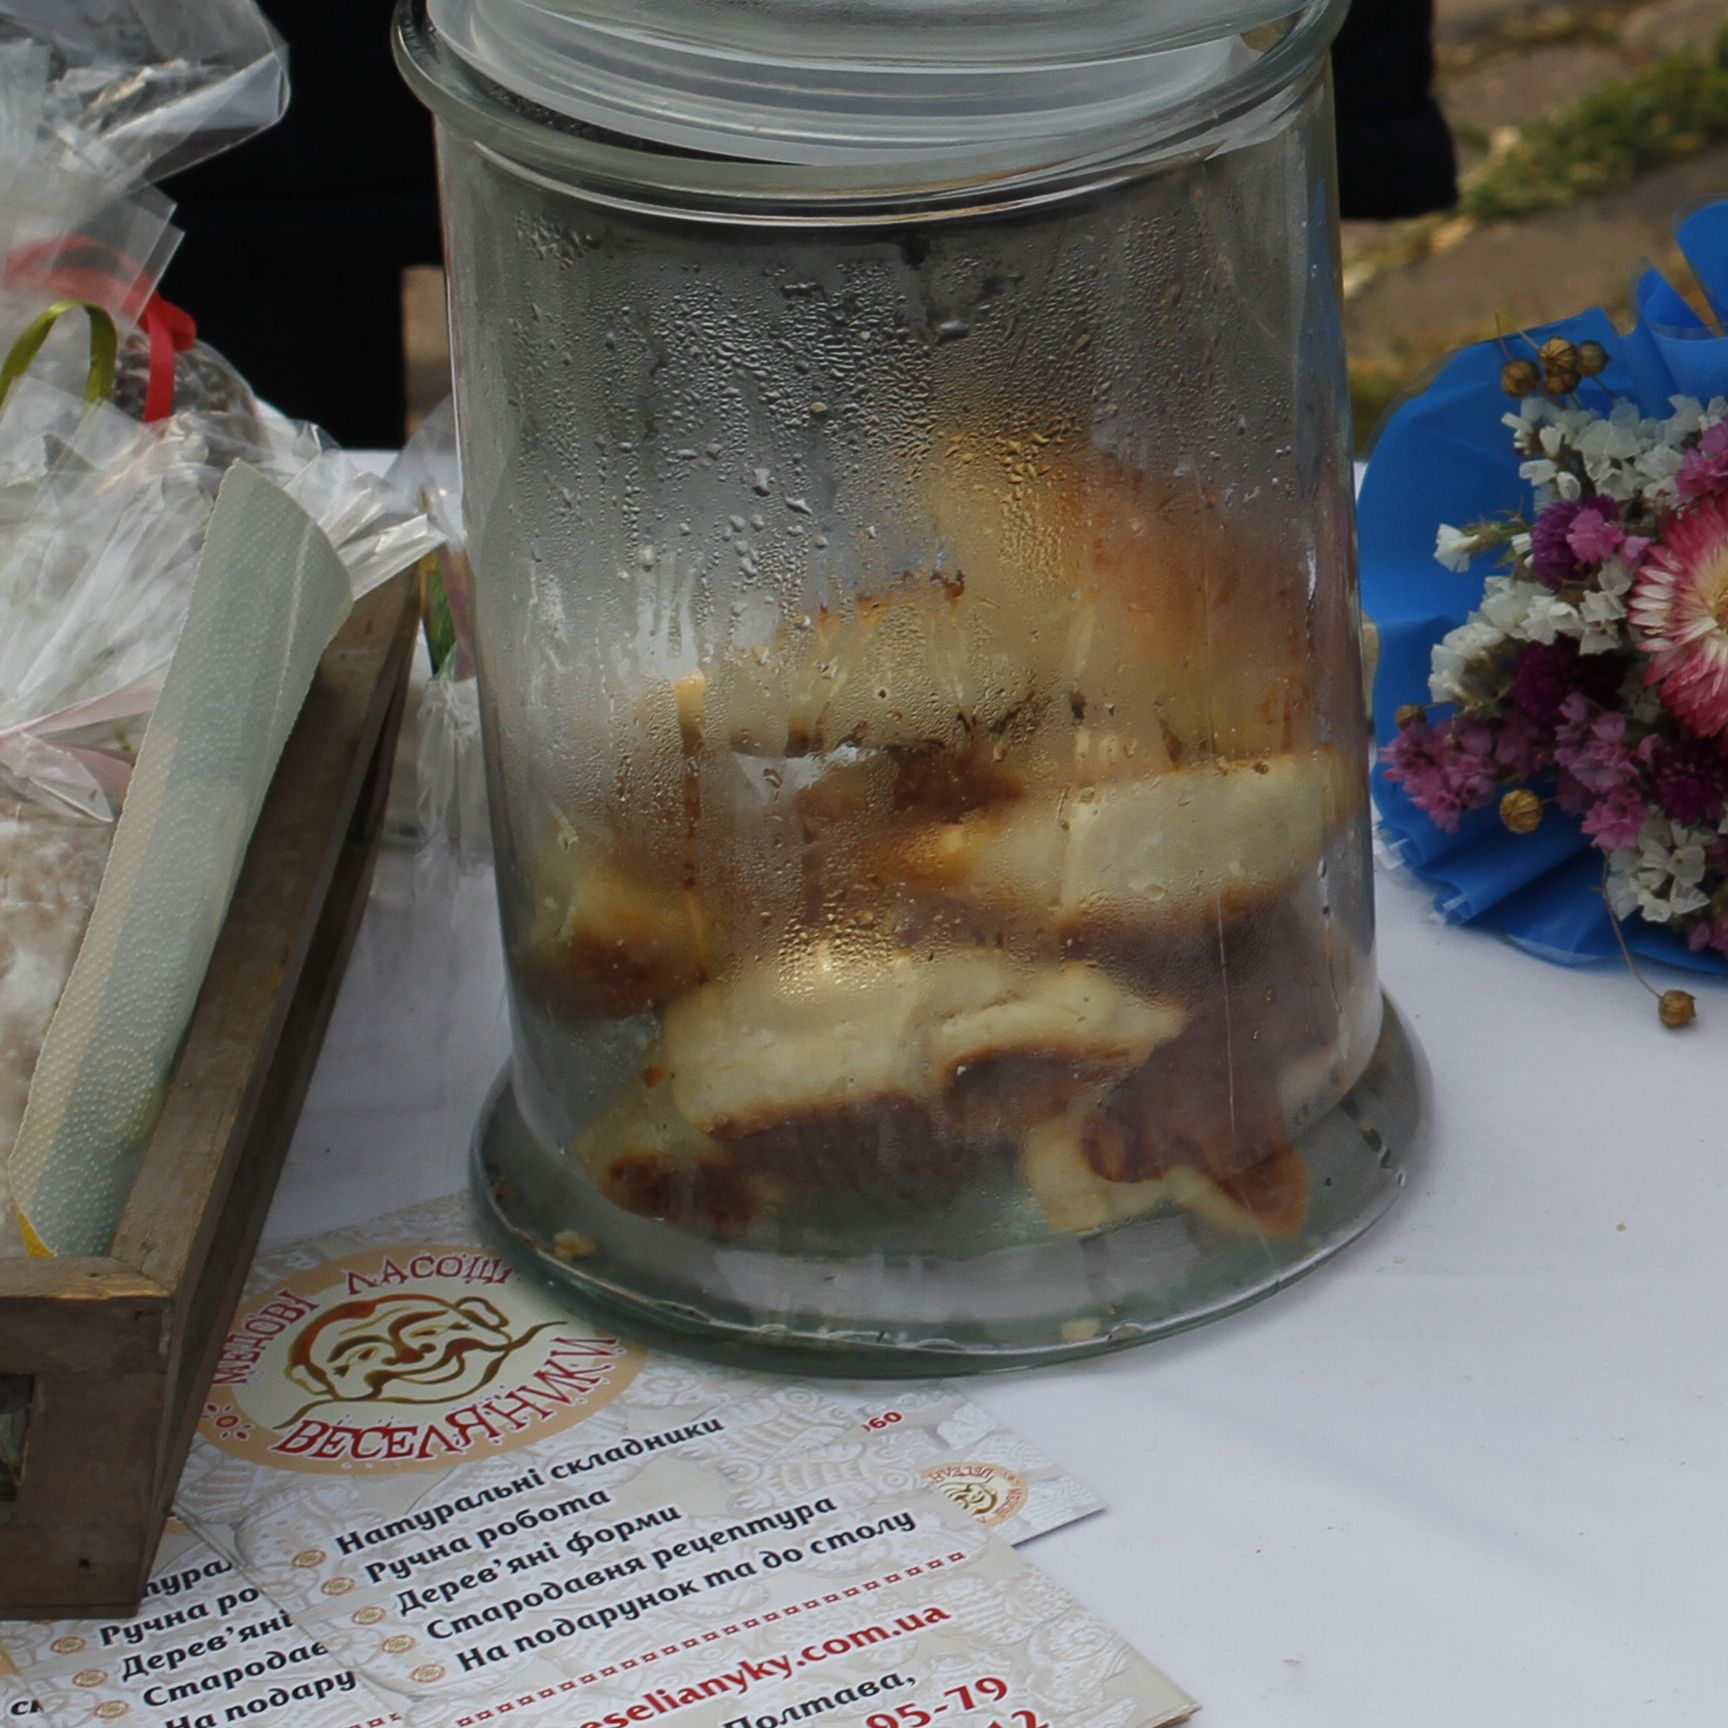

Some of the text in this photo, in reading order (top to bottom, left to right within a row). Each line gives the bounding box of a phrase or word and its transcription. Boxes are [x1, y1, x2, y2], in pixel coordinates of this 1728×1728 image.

[211, 1288, 321, 1386] МЕДОВІ
[271, 1336, 618, 1461] ВЕСЕЛЯНИКИ
[335, 1416, 725, 1555] Натуральні складники
[365, 1487, 612, 1585] Ручна робота
[565, 1504, 683, 1557] форми
[426, 1495, 838, 1640] Стародавня рецептура
[456, 1509, 917, 1673] На подарунок та до столу
[99, 1601, 210, 1648] Ручна
